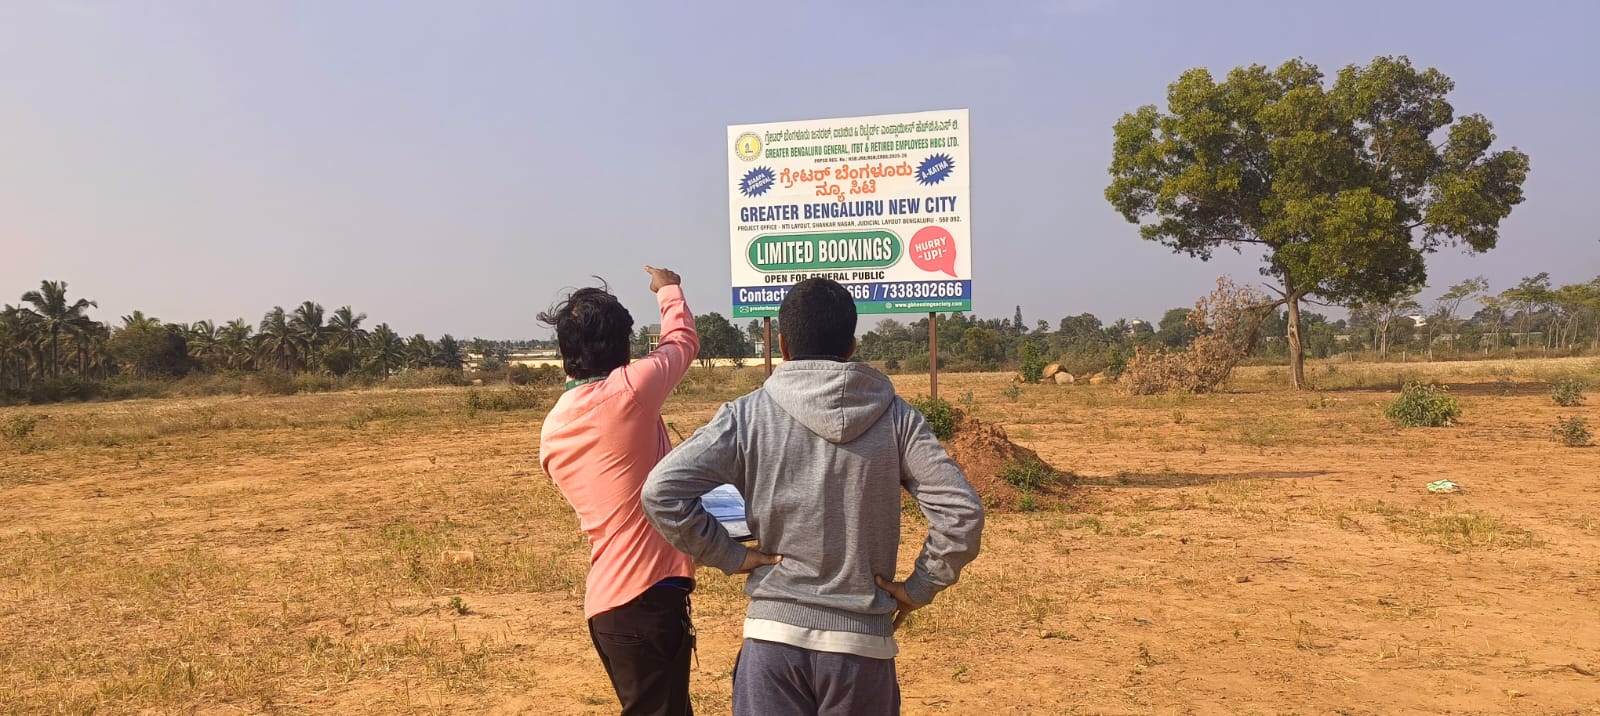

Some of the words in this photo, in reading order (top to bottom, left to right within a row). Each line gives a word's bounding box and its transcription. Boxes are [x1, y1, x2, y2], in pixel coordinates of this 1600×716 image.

[765, 148, 789, 159] GREATER
[790, 146, 822, 157] BENGALURU
[823, 144, 850, 154] GENERAL,
[851, 143, 864, 154] ITBT
[864, 143, 869, 153] &
[870, 141, 894, 152] RETIRED
[895, 139, 929, 151] EMPLOYEES
[947, 136, 959, 147] LTD.
[780, 167, 831, 188] ಗ್ರೇಟರ್
[834, 161, 912, 179] ಬೆಂಗಳೂರು
[921, 160, 949, 179] A-KATHA
[815, 181, 846, 203] ನ್ಯೂ
[850, 179, 876, 195] ಸಿಟಿ
[740, 204, 799, 222] GREATER
[804, 200, 884, 219] BENGALURU
[889, 198, 921, 215] NEW
[925, 196, 957, 213] CITY
[812, 221, 836, 229] SHANKAR
[757, 241, 813, 265] LIMITED
[818, 237, 892, 262] BOOKINGS
[915, 237, 947, 253] HURRY
[764, 274, 788, 284] OPEN
[790, 273, 808, 283] FOR
[852, 271, 885, 281] PUBLIC
[872, 284, 879, 300] /
[881, 282, 963, 299] 7338302666
